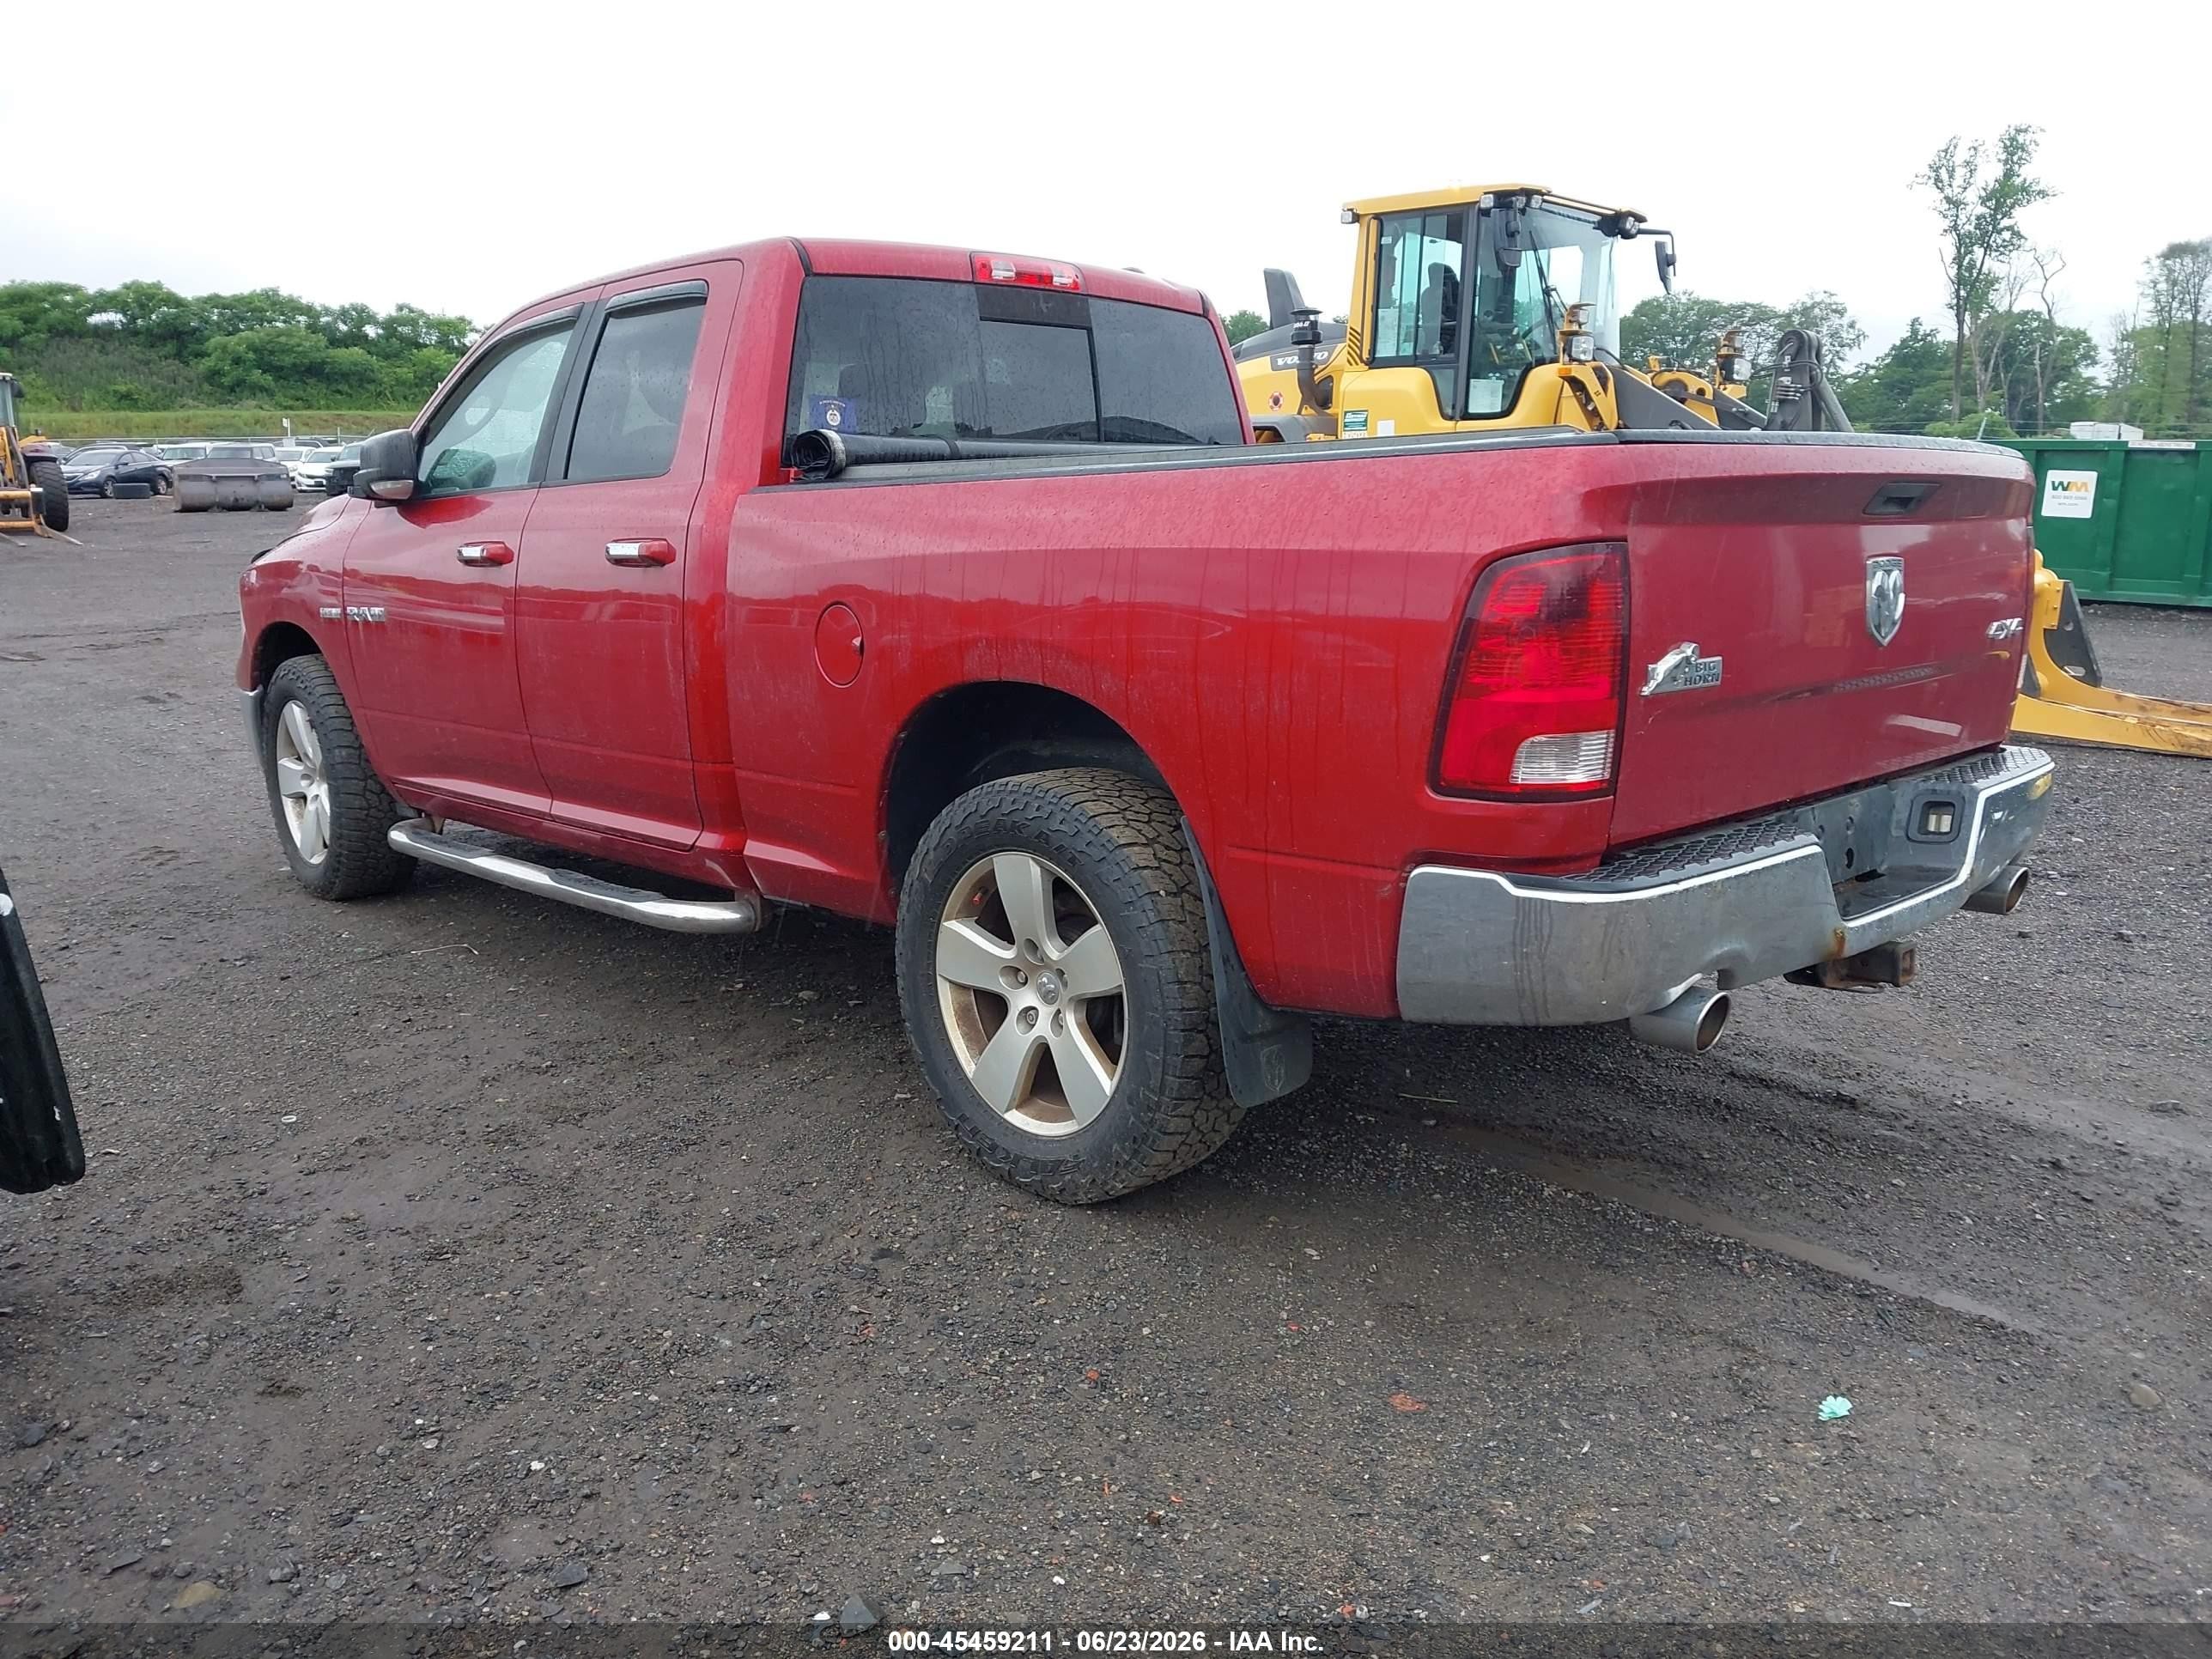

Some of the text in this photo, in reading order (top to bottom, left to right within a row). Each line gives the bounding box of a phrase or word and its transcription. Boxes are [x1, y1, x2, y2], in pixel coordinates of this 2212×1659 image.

[2051, 480, 2089, 493] WM
[1695, 660, 1718, 673] BIG
[1684, 672, 1720, 686] HORN
